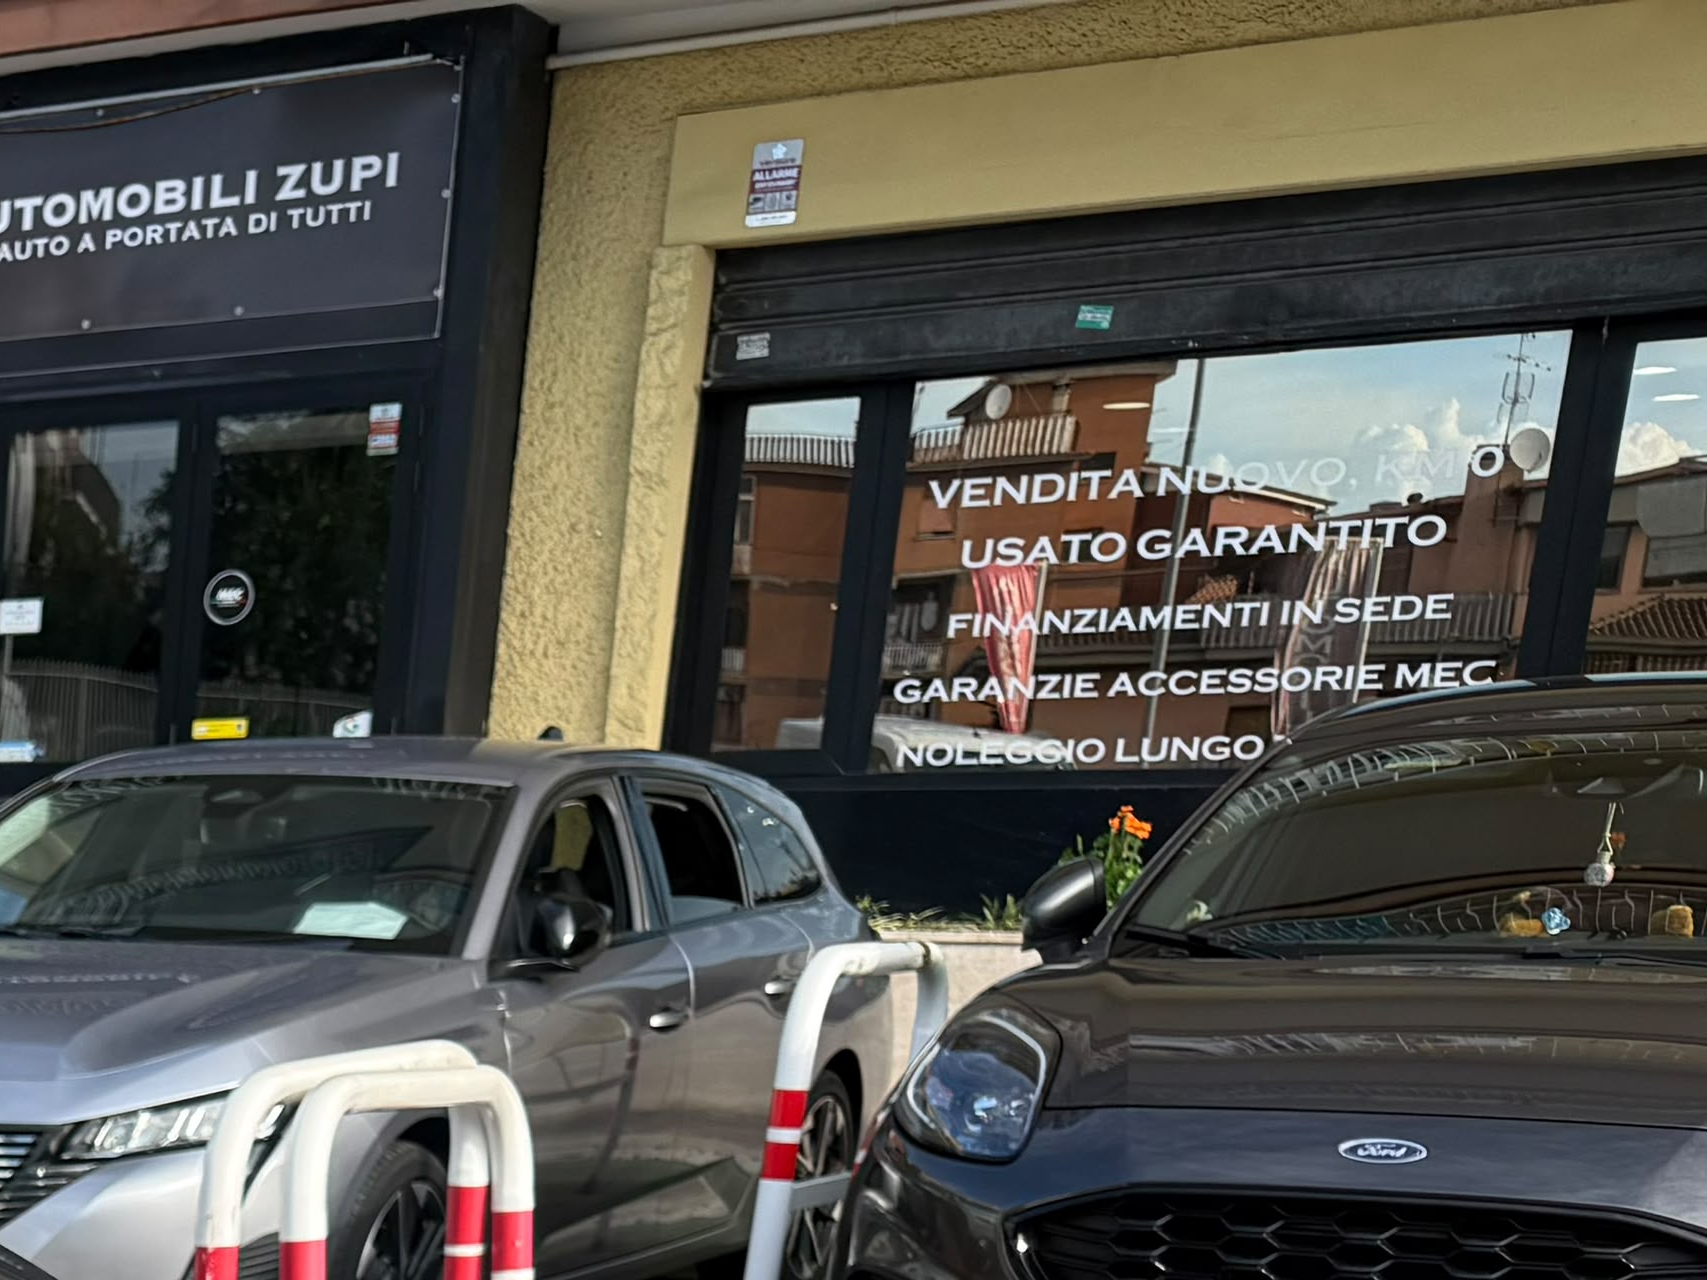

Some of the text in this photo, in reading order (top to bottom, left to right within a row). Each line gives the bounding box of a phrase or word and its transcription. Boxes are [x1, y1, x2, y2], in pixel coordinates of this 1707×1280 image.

[274, 152, 400, 202] ZUPI
[77, 232, 95, 254] A
[105, 217, 238, 251] PORTATA
[248, 211, 277, 235] DI
[287, 201, 372, 229] TUTTI
[928, 468, 1145, 509] VENDITA
[1156, 456, 1356, 498] NUOVO,
[962, 514, 1448, 570] USATO GARANTITO
[946, 600, 1269, 639] FINANZIAMENTI
[1280, 598, 1324, 626] IN
[1333, 593, 1455, 624] SEDE
[893, 672, 1102, 704] GARANZIE
[1107, 664, 1385, 698] ACCESSORIE
[896, 734, 1265, 768] NOLEGGIO LUNGO
